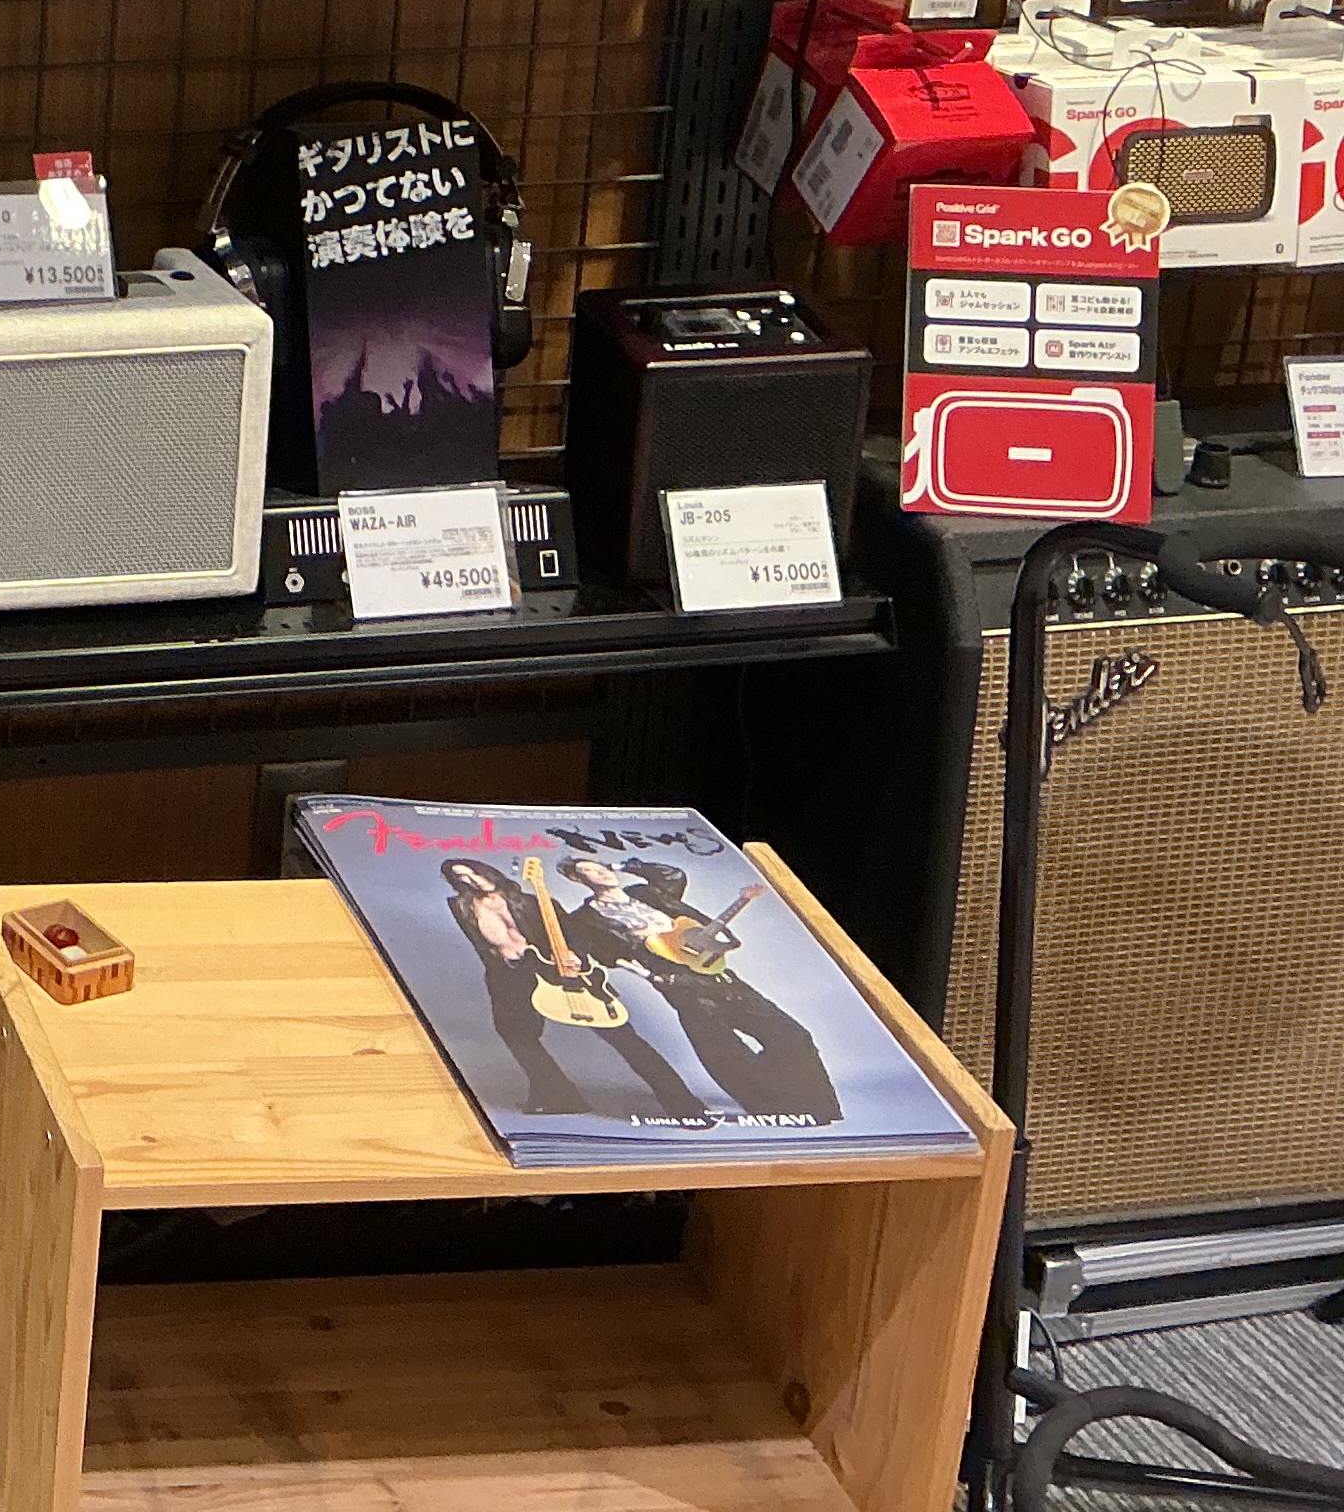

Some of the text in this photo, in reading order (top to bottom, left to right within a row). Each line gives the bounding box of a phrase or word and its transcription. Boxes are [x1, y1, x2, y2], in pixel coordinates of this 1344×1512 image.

[1066, 107, 1136, 120] Spark GO
[298, 119, 475, 179] ギタリストに
[302, 166, 466, 224] かつてない
[936, 202, 998, 214] Positive Grid
[307, 207, 475, 270] 演奏体験を
[965, 225, 1091, 248] Spark GO
[24, 265, 97, 285] ¥13,500
[350, 514, 417, 531] WAZA-AIR
[680, 510, 731, 525] JB-205
[420, 566, 492, 589] ¥49,500
[750, 562, 820, 583] ¥15,000
[323, 810, 559, 856] Fender
[737, 1115, 816, 1127] MIYAVI
